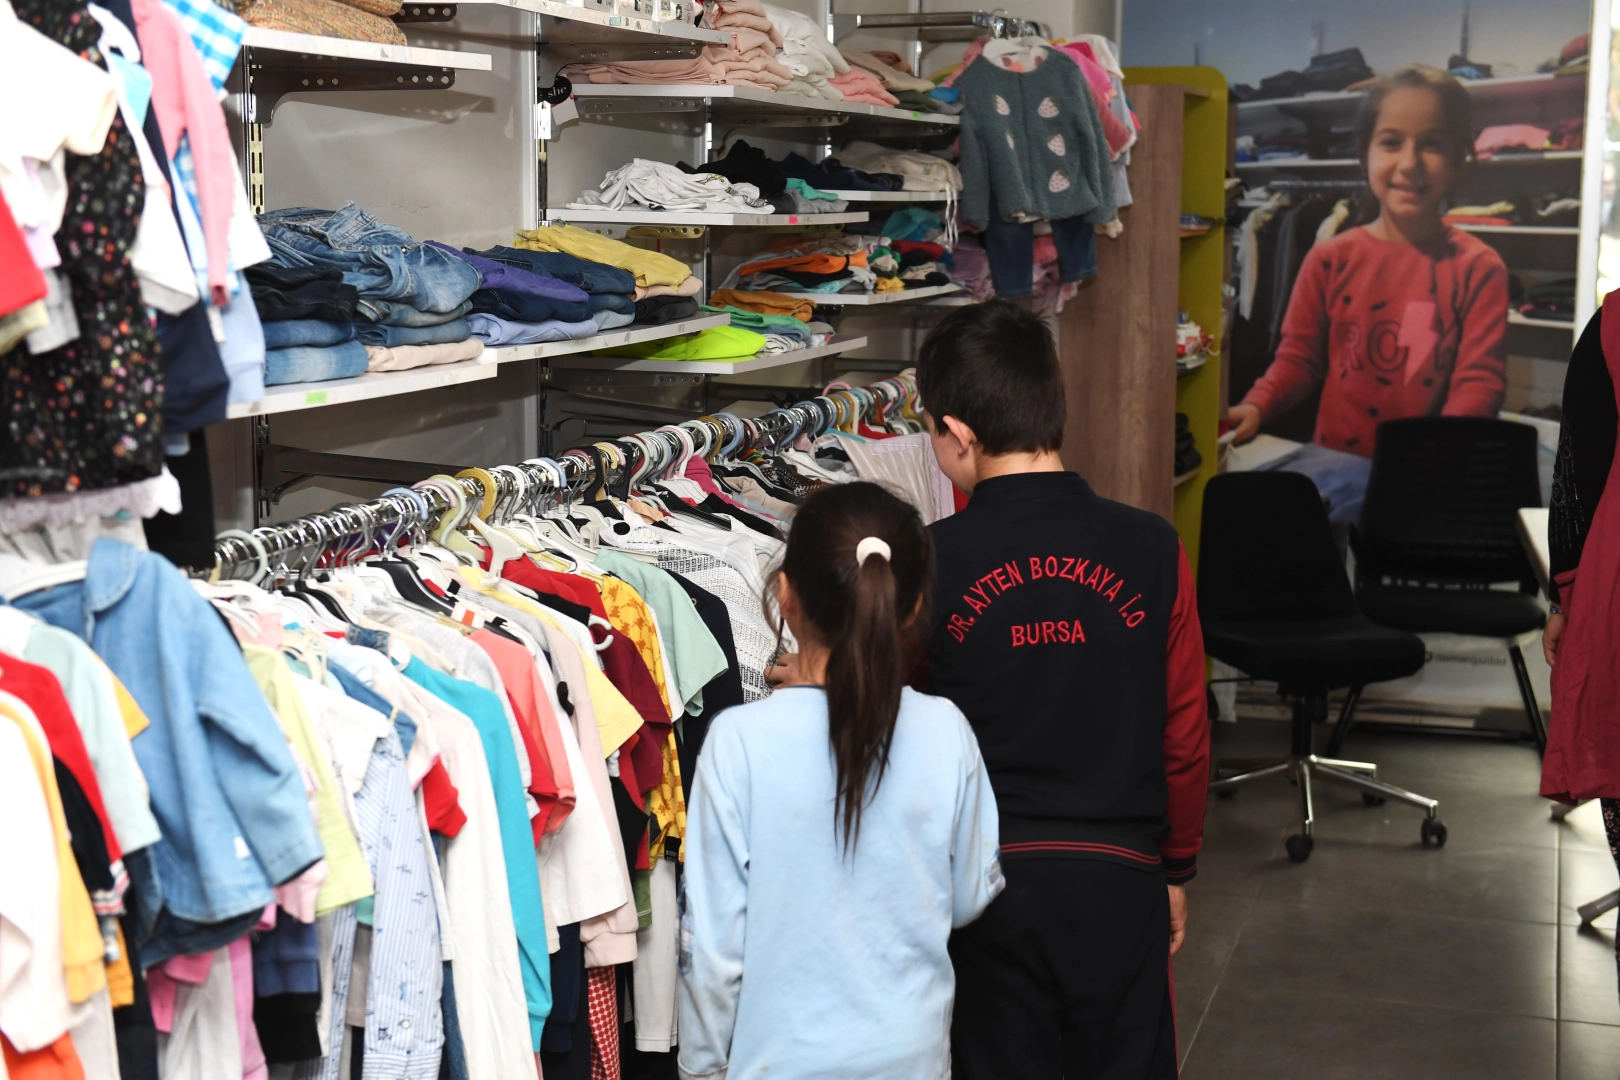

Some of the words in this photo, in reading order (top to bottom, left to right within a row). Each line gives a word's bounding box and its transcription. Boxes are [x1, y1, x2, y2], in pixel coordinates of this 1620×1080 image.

[548, 86, 567, 98] she
[947, 613, 976, 643] DR.
[962, 559, 1024, 615] AYTEN
[1029, 555, 1124, 603] BOZKAYA
[1011, 619, 1086, 647] BURSA
